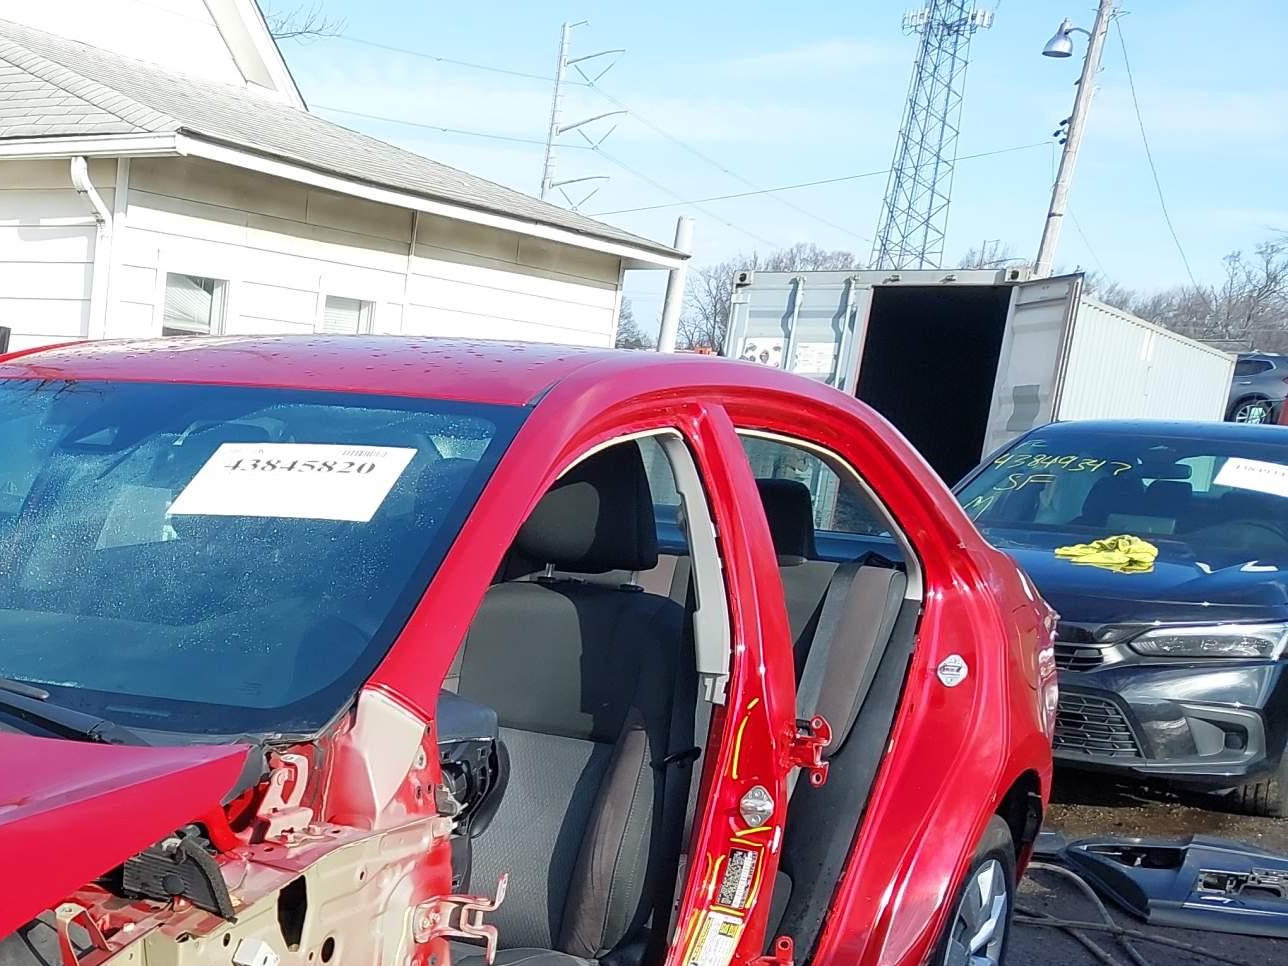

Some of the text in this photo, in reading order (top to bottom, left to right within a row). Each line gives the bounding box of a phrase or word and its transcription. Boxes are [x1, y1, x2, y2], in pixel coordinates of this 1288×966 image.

[223, 457, 377, 475] 43845820
[993, 452, 1133, 477] 43849347
[992, 473, 1058, 492] SF
